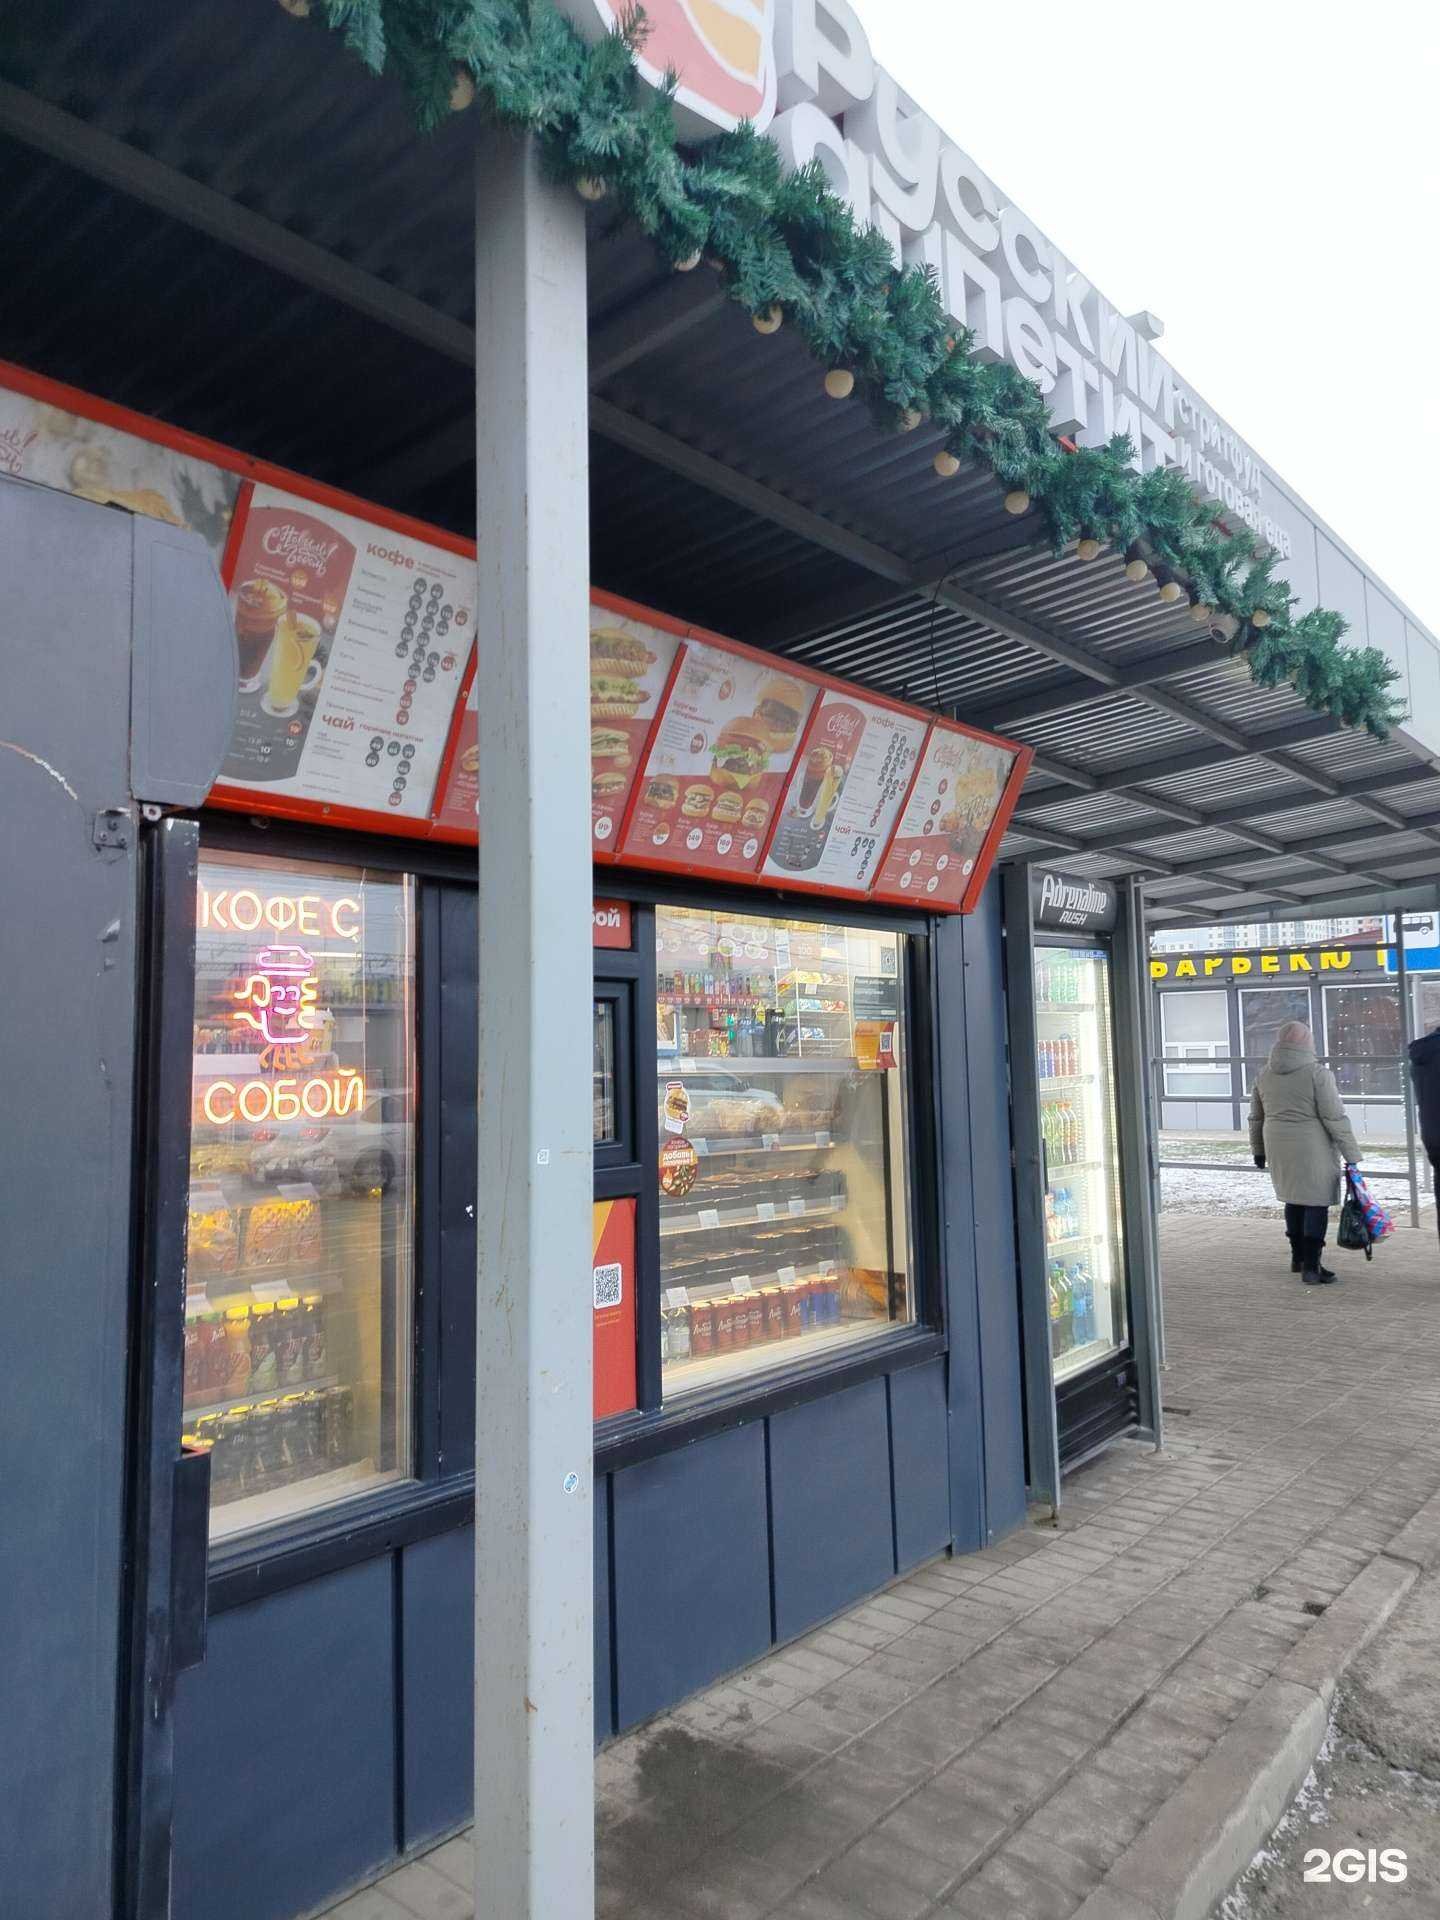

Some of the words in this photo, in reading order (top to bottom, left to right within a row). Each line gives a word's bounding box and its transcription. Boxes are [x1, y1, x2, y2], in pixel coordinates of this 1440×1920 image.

[366, 542, 415, 570] кофе
[322, 713, 355, 732] чай
[203, 890, 321, 936] КОФЕ
[331, 898, 360, 938] С
[1040, 873, 1107, 919] Adrenaline
[1059, 910, 1088, 926] RUSH
[203, 1068, 364, 1125] СОБОЙ
